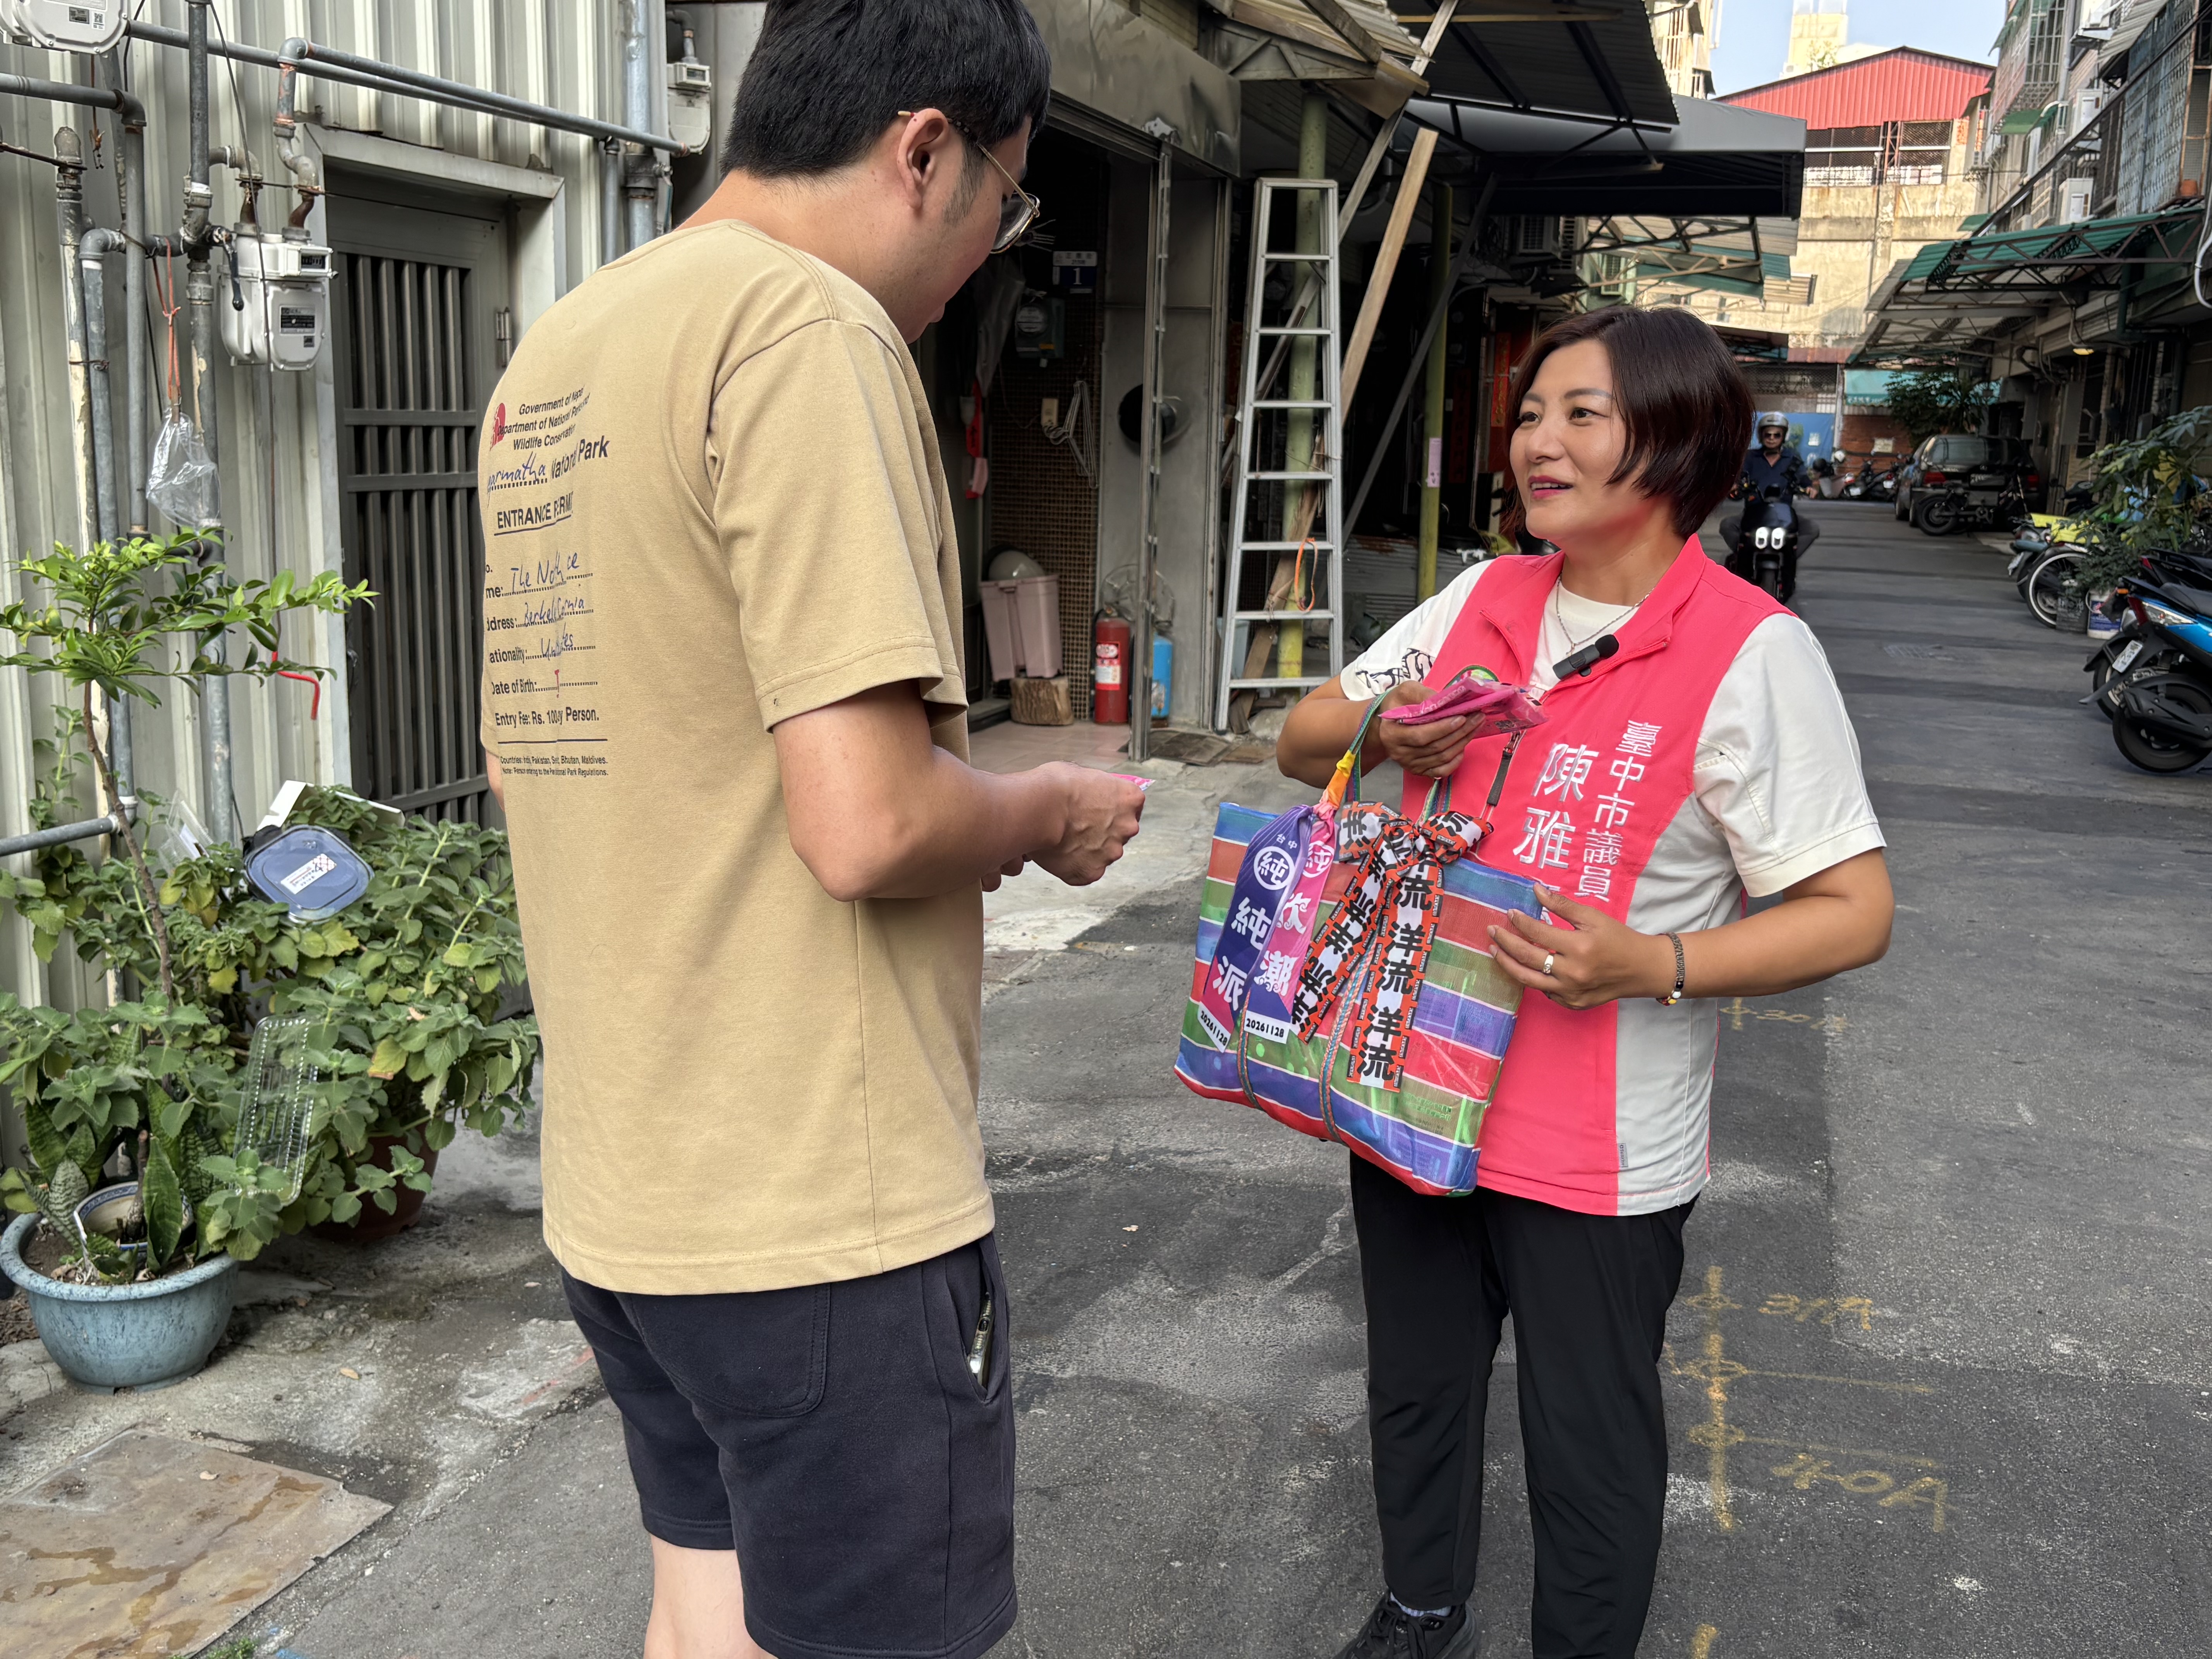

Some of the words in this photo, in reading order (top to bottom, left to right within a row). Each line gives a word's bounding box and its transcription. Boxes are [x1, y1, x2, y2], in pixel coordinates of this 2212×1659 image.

[1073, 268, 1082, 285] 1
[519, 396, 564, 416] Government
[539, 416, 547, 430] of
[513, 435, 542, 451] Wildlife
[579, 434, 610, 462] Park
[497, 502, 551, 529] ENTRANCE
[512, 679, 519, 693] of
[495, 712, 517, 729] Entry
[531, 710, 545, 725] Rs.
[566, 706, 599, 722] Person.
[582, 756, 608, 764] Maldives.
[1575, 720, 1662, 902] 臺中市議員
[1276, 833, 1299, 850] 台中
[1512, 743, 1599, 926] 陳雅
[1257, 850, 1290, 886] 純
[1212, 896, 1272, 1011] 純派
[1200, 1009, 1228, 1047] 20261128
[1245, 1017, 1285, 1039] 20261128
